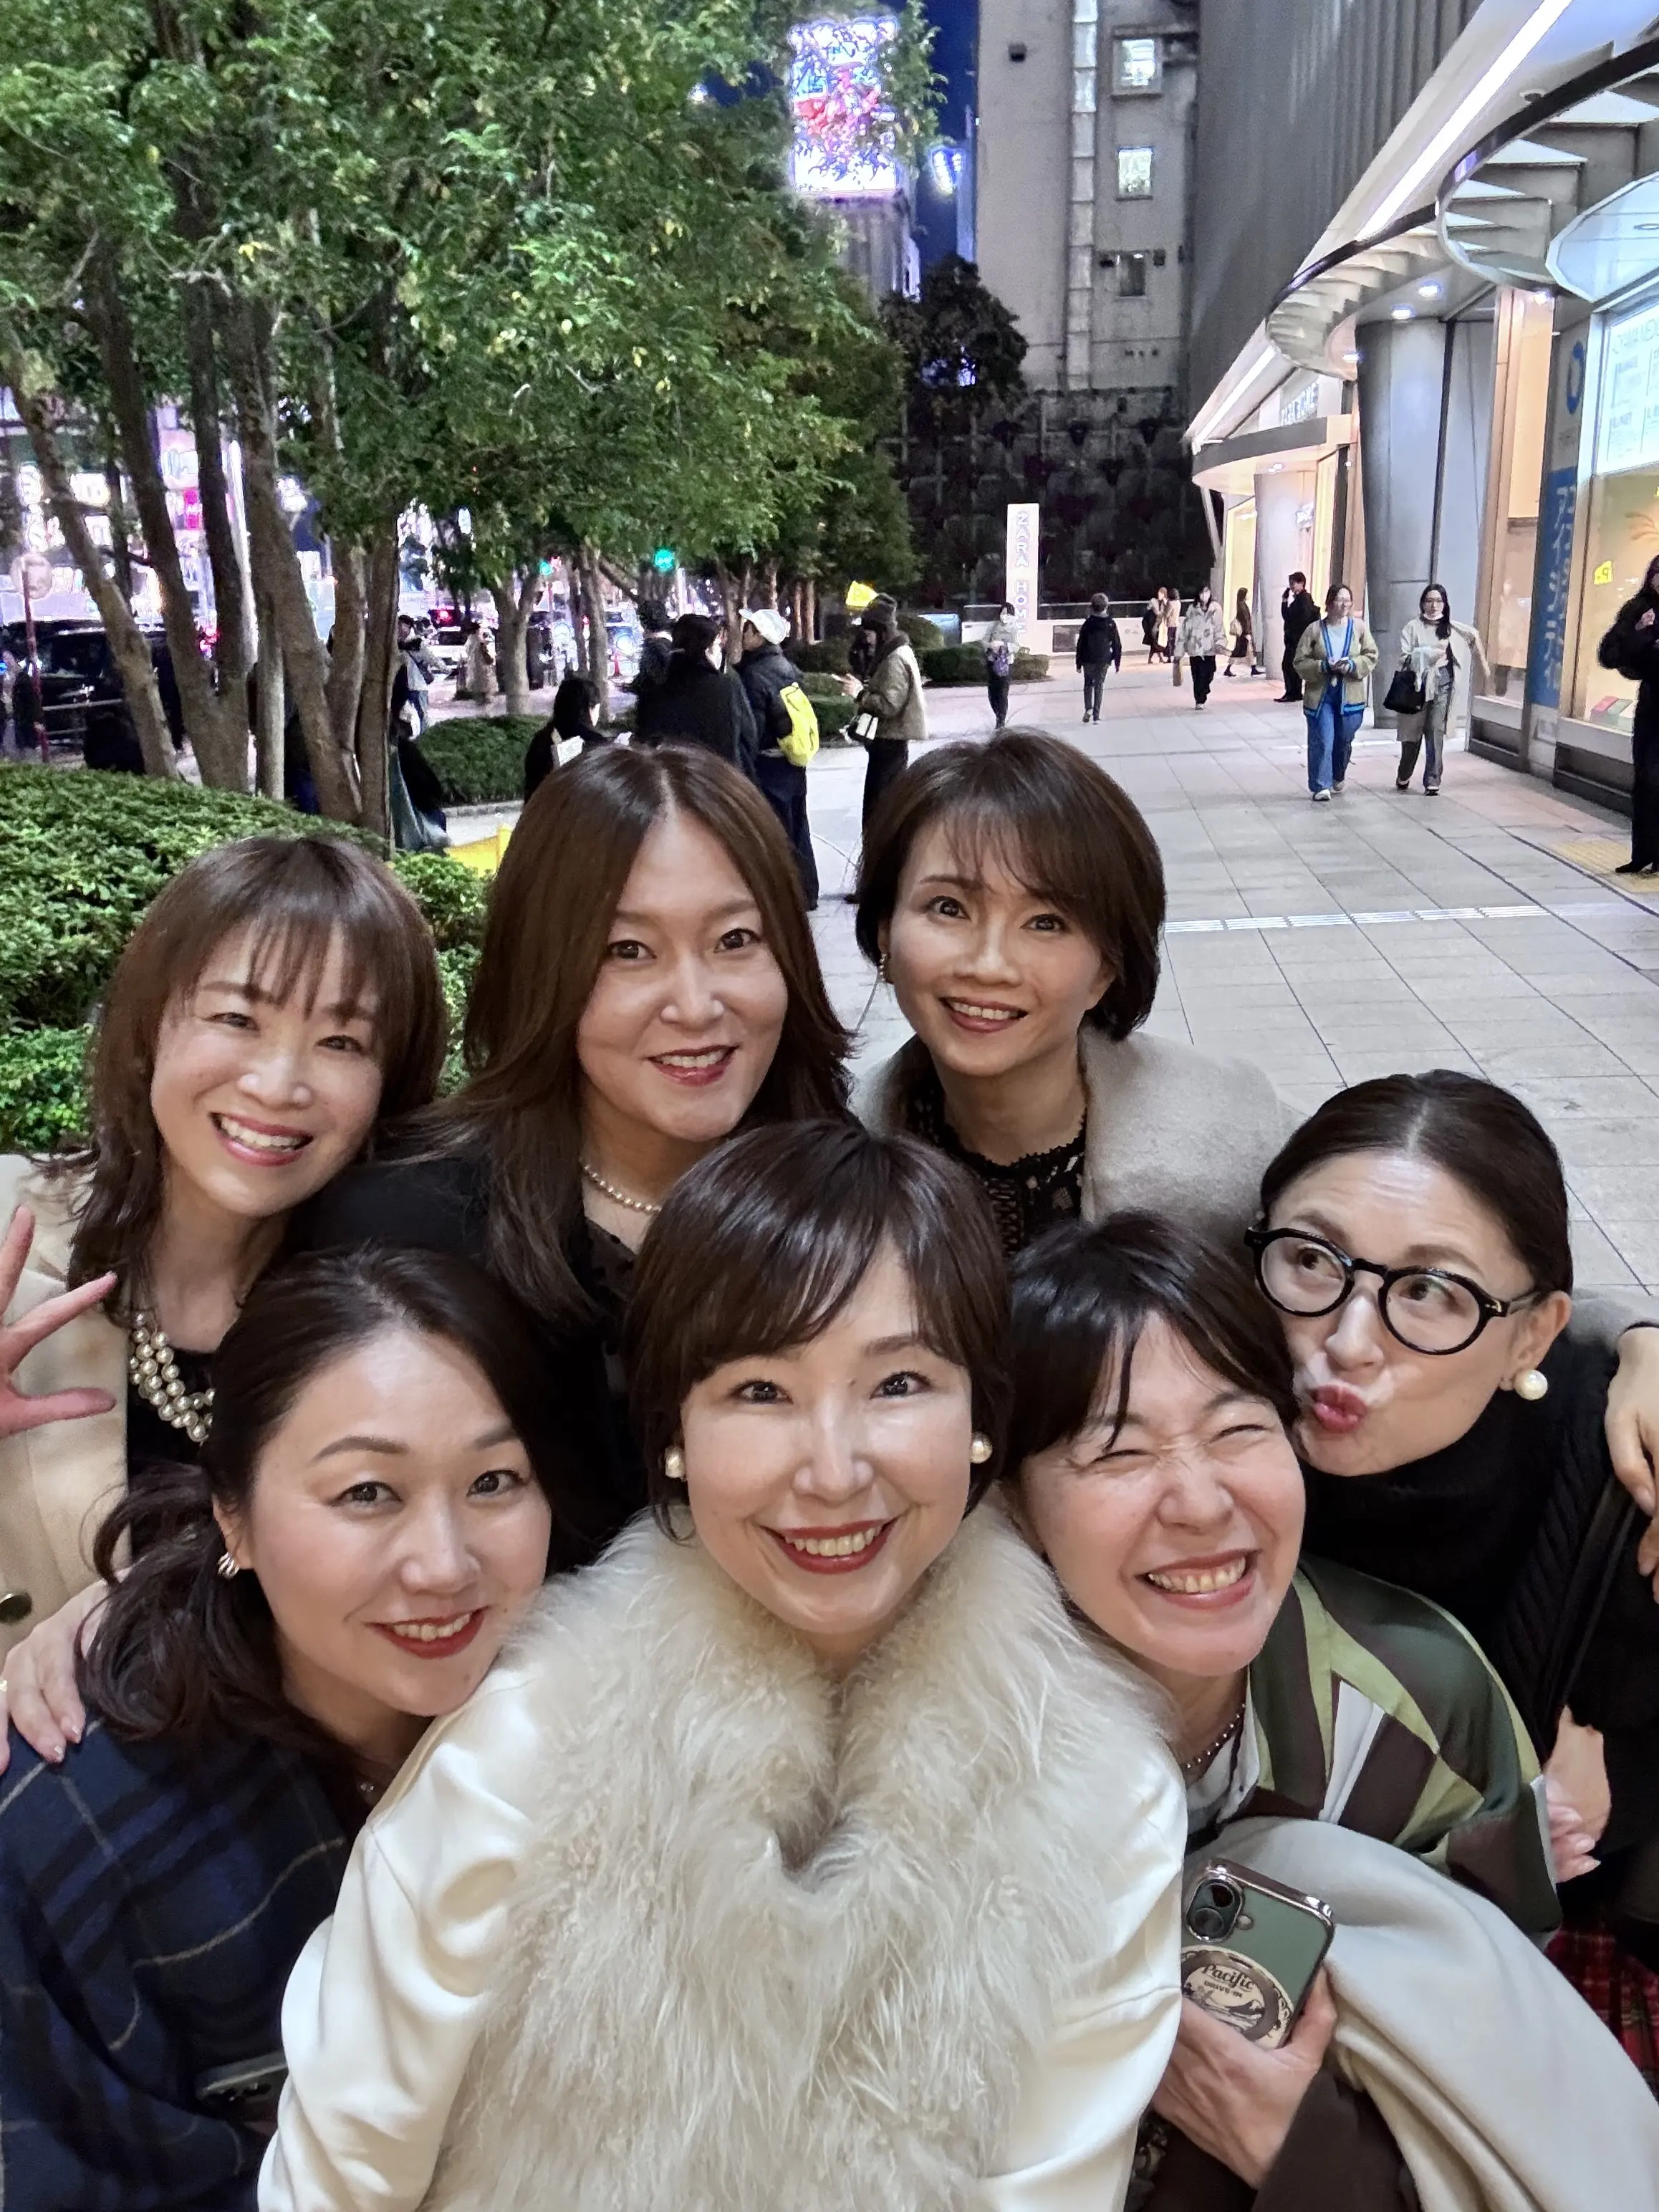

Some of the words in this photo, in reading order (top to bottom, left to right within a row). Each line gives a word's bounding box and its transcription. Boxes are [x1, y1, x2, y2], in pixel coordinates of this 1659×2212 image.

[1015, 511, 1029, 567] ZARA
[1014, 580, 1029, 634] HOME
[1202, 1964, 1253, 1990] Pacific
